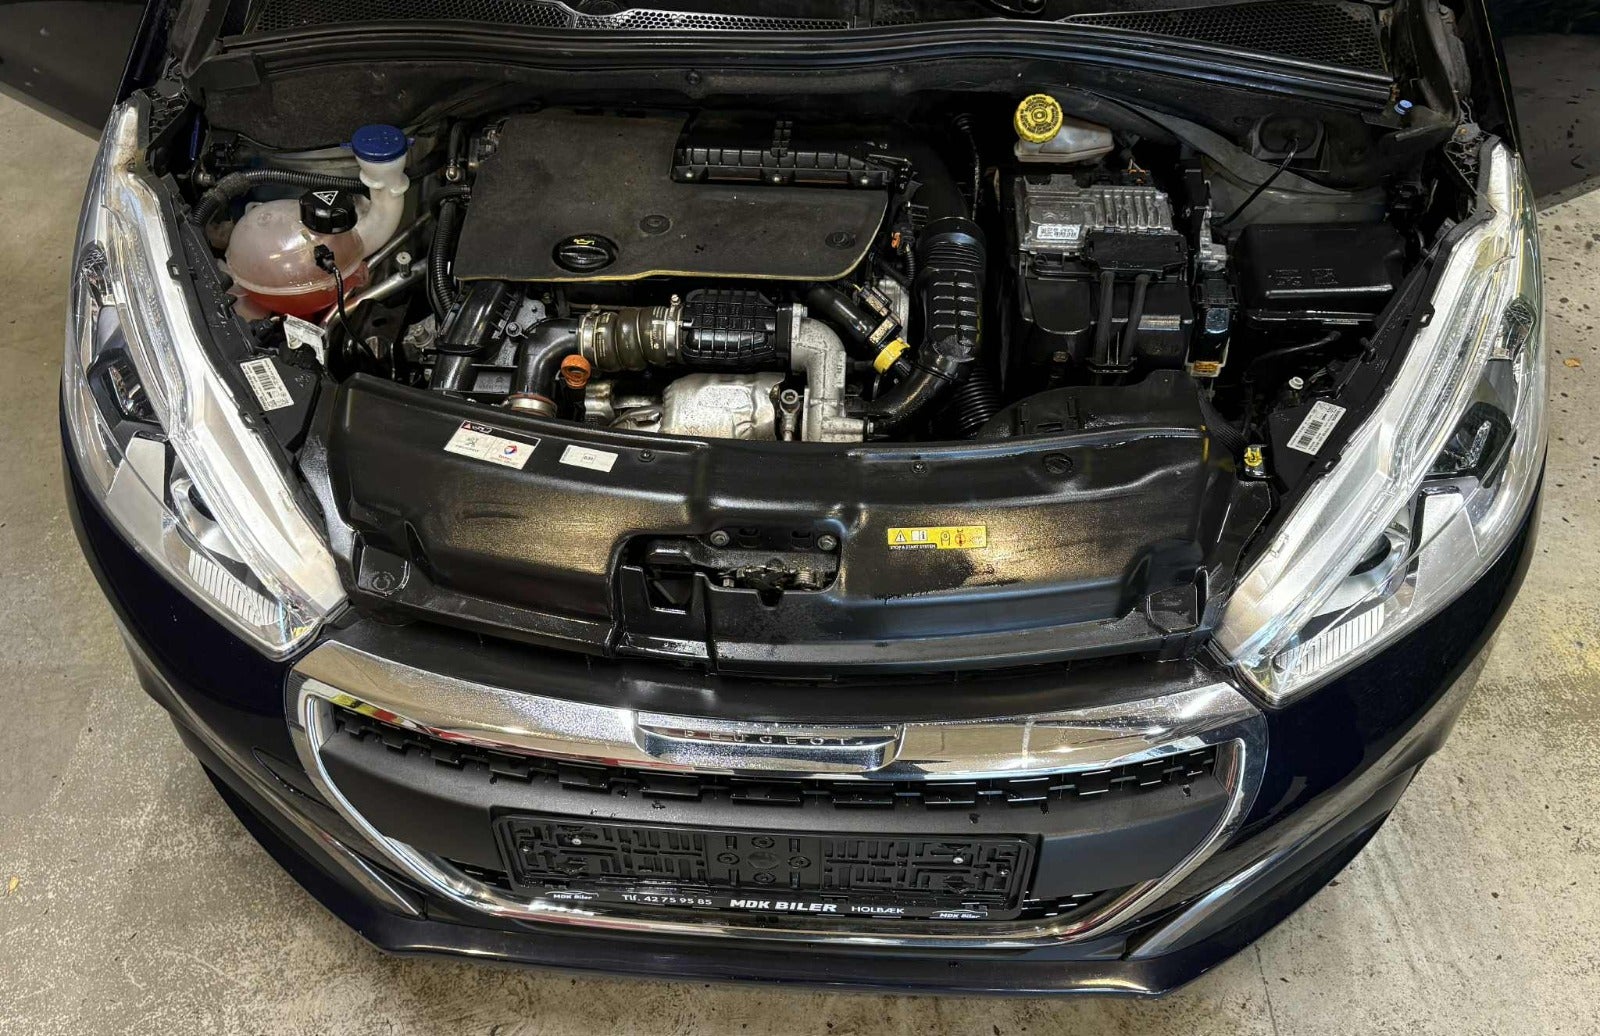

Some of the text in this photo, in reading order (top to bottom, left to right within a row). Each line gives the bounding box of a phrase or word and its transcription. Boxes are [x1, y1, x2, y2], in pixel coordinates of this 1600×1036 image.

[684, 728, 849, 745] PEUGEOT
[644, 895, 659, 903] 42
[661, 896, 677, 904] 75
[680, 897, 694, 905] 95
[697, 898, 712, 906] 85
[729, 899, 838, 913] MDK BILER
[851, 905, 905, 915] HOLBÆK
